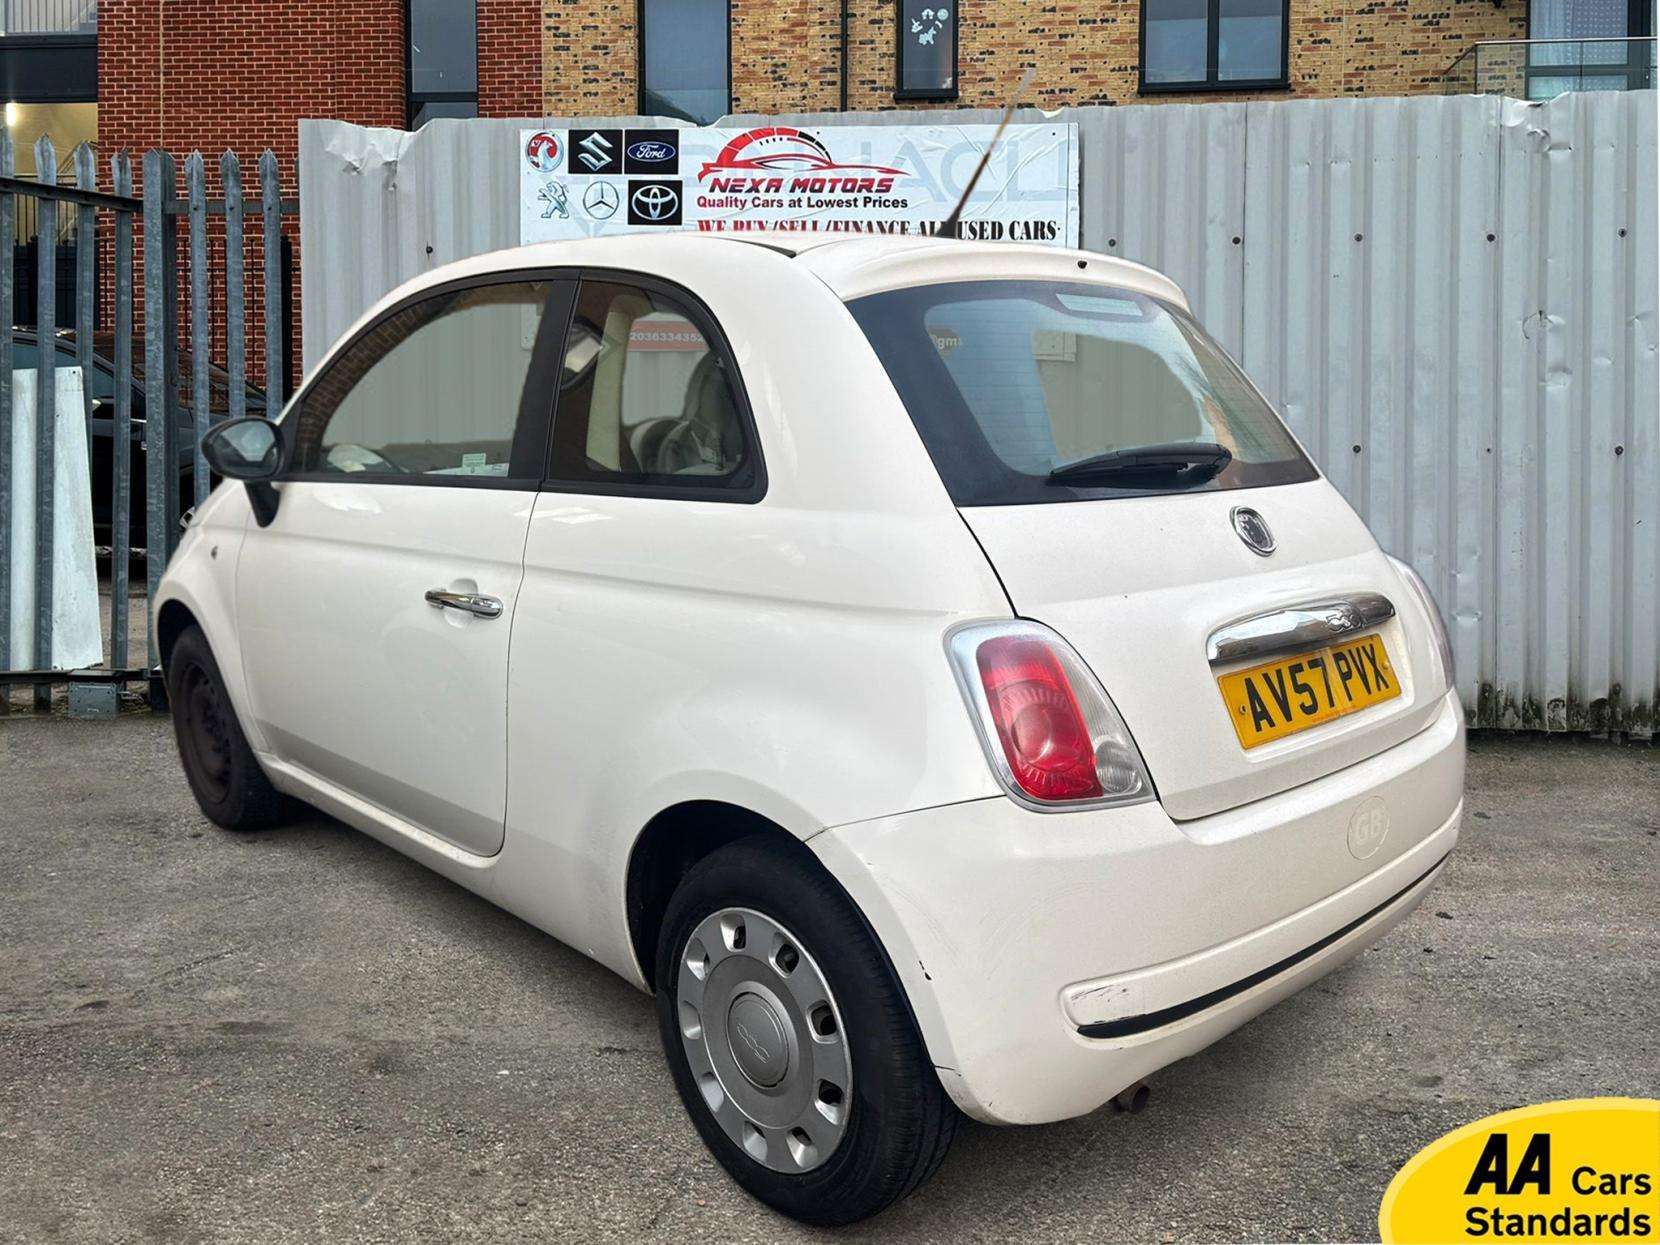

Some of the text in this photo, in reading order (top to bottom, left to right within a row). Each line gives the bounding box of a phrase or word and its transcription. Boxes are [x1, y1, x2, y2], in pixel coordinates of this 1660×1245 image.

[637, 144, 666, 159] Ford
[709, 178, 894, 193] NEXA MOTORS
[697, 196, 908, 210] Quality Cars at Lowest Prices
[697, 220, 726, 231] WE
[957, 220, 1004, 241] USED
[1009, 220, 1057, 240] CARS
[1244, 643, 1389, 732] AV57 PVX
